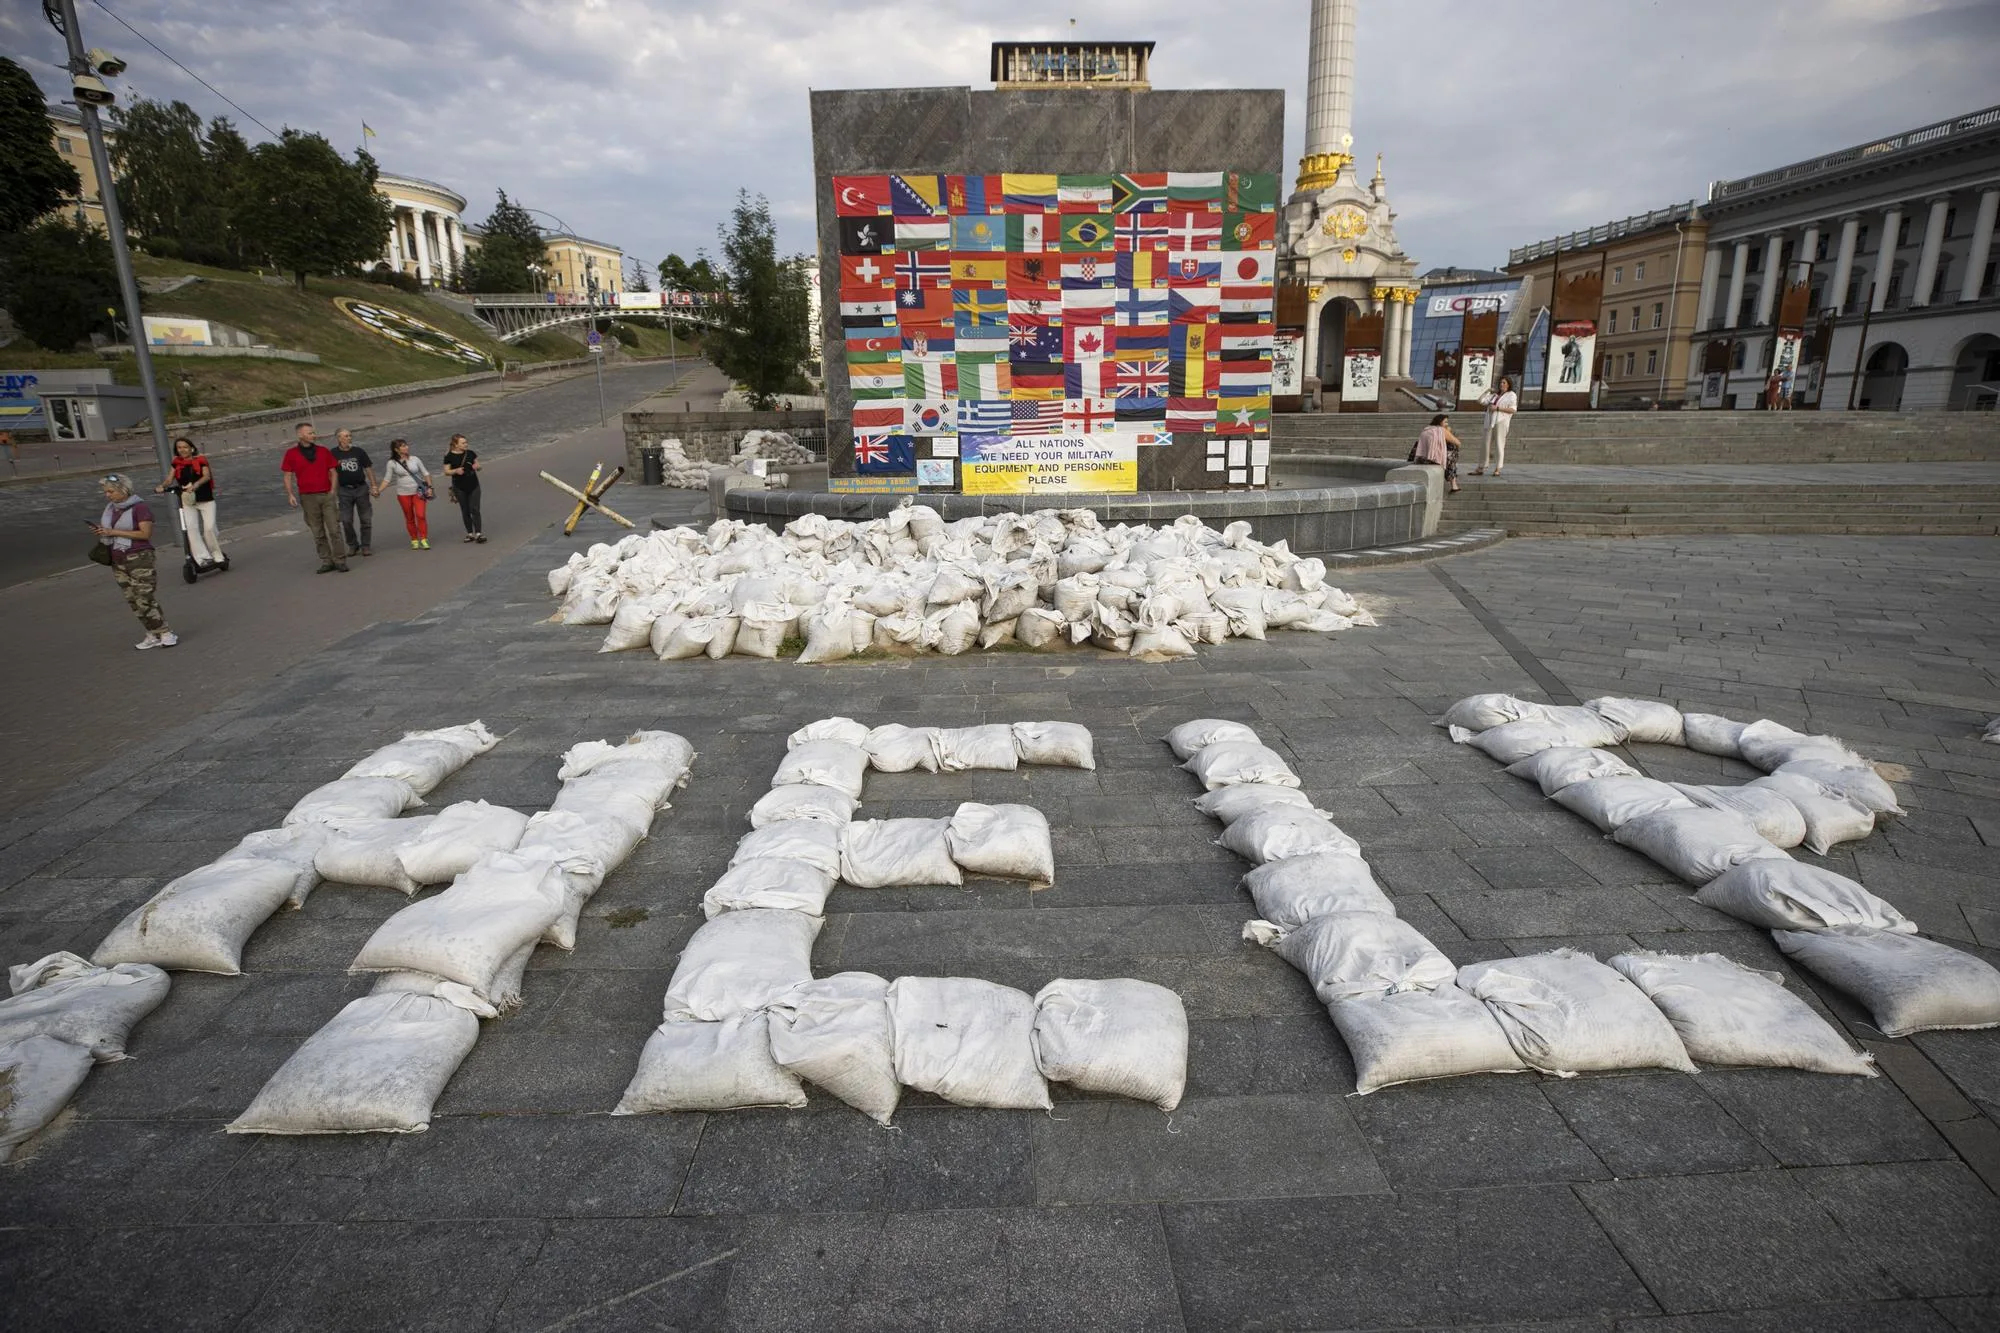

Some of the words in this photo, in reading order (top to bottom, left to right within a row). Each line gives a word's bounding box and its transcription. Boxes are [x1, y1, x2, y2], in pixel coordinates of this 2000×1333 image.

[1434, 293, 1508, 312] GLOBUS
[1015, 440, 1034, 449] ALL
[1039, 439, 1084, 448] NATIONS
[981, 452, 997, 461] WE
[1002, 452, 1030, 461] NEED
[1034, 451, 1063, 460] YOUR
[1067, 450, 1114, 460] MILITARY
[974, 464, 1033, 474] EQUIPMENT
[1038, 464, 1059, 473] AND
[1064, 462, 1125, 472] PERSONNEL
[1028, 475, 1067, 485] PLEASE
